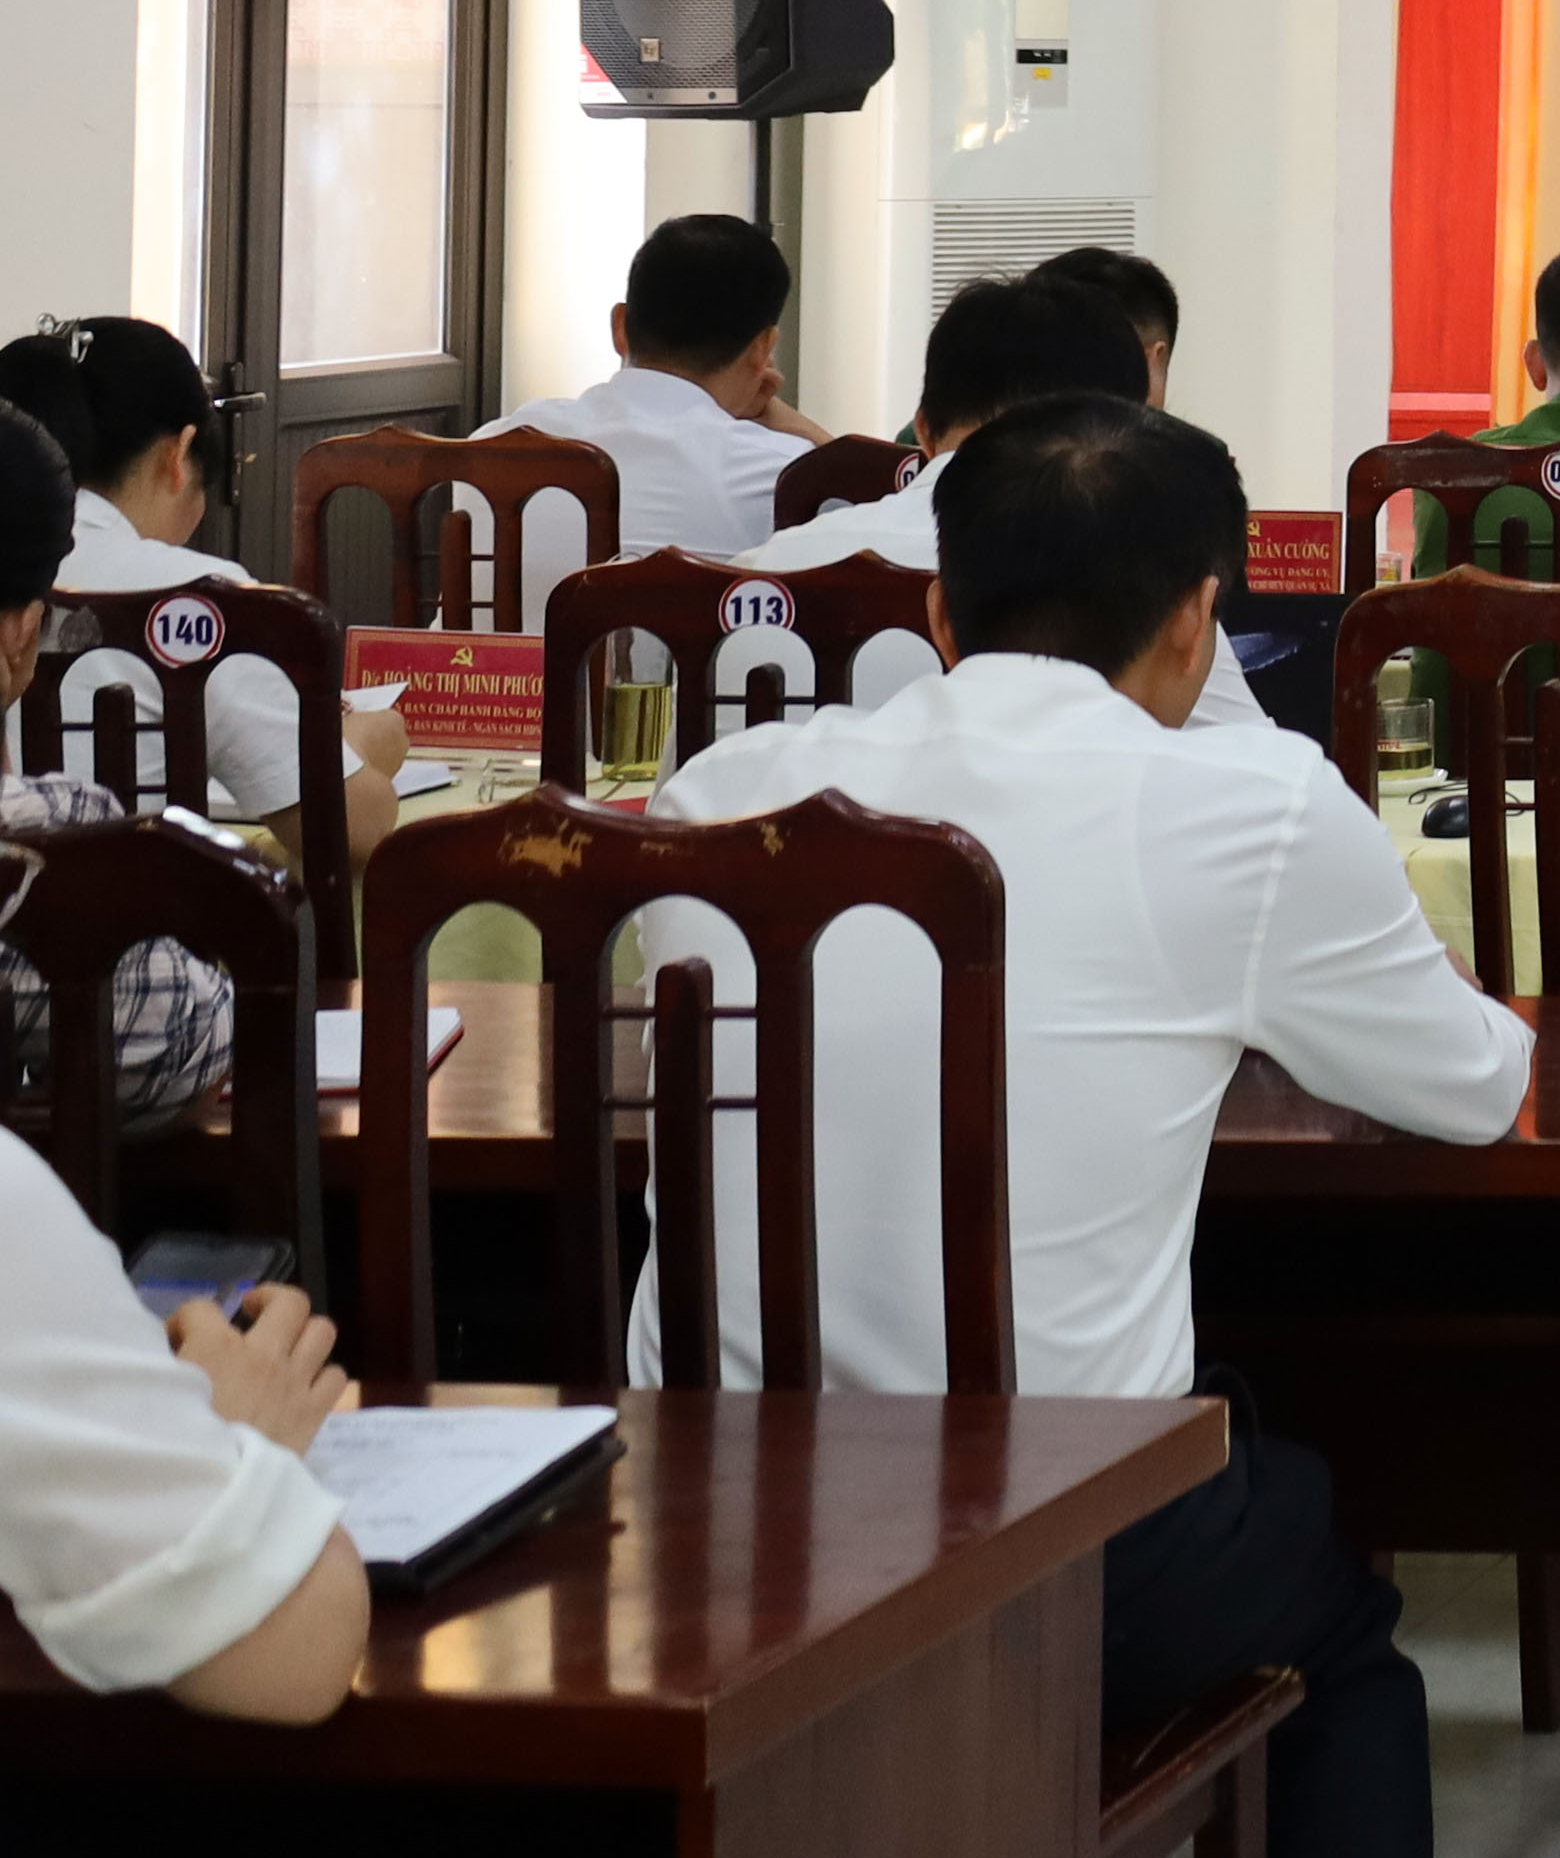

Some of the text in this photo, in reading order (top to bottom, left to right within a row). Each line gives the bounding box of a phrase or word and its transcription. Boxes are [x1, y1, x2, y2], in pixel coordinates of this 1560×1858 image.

[730, 596, 784, 626] 113
[158, 614, 213, 646] 140
[436, 673, 460, 698] THỊ
[464, 673, 500, 696] MINH
[503, 673, 544, 697] PHƯƠ
